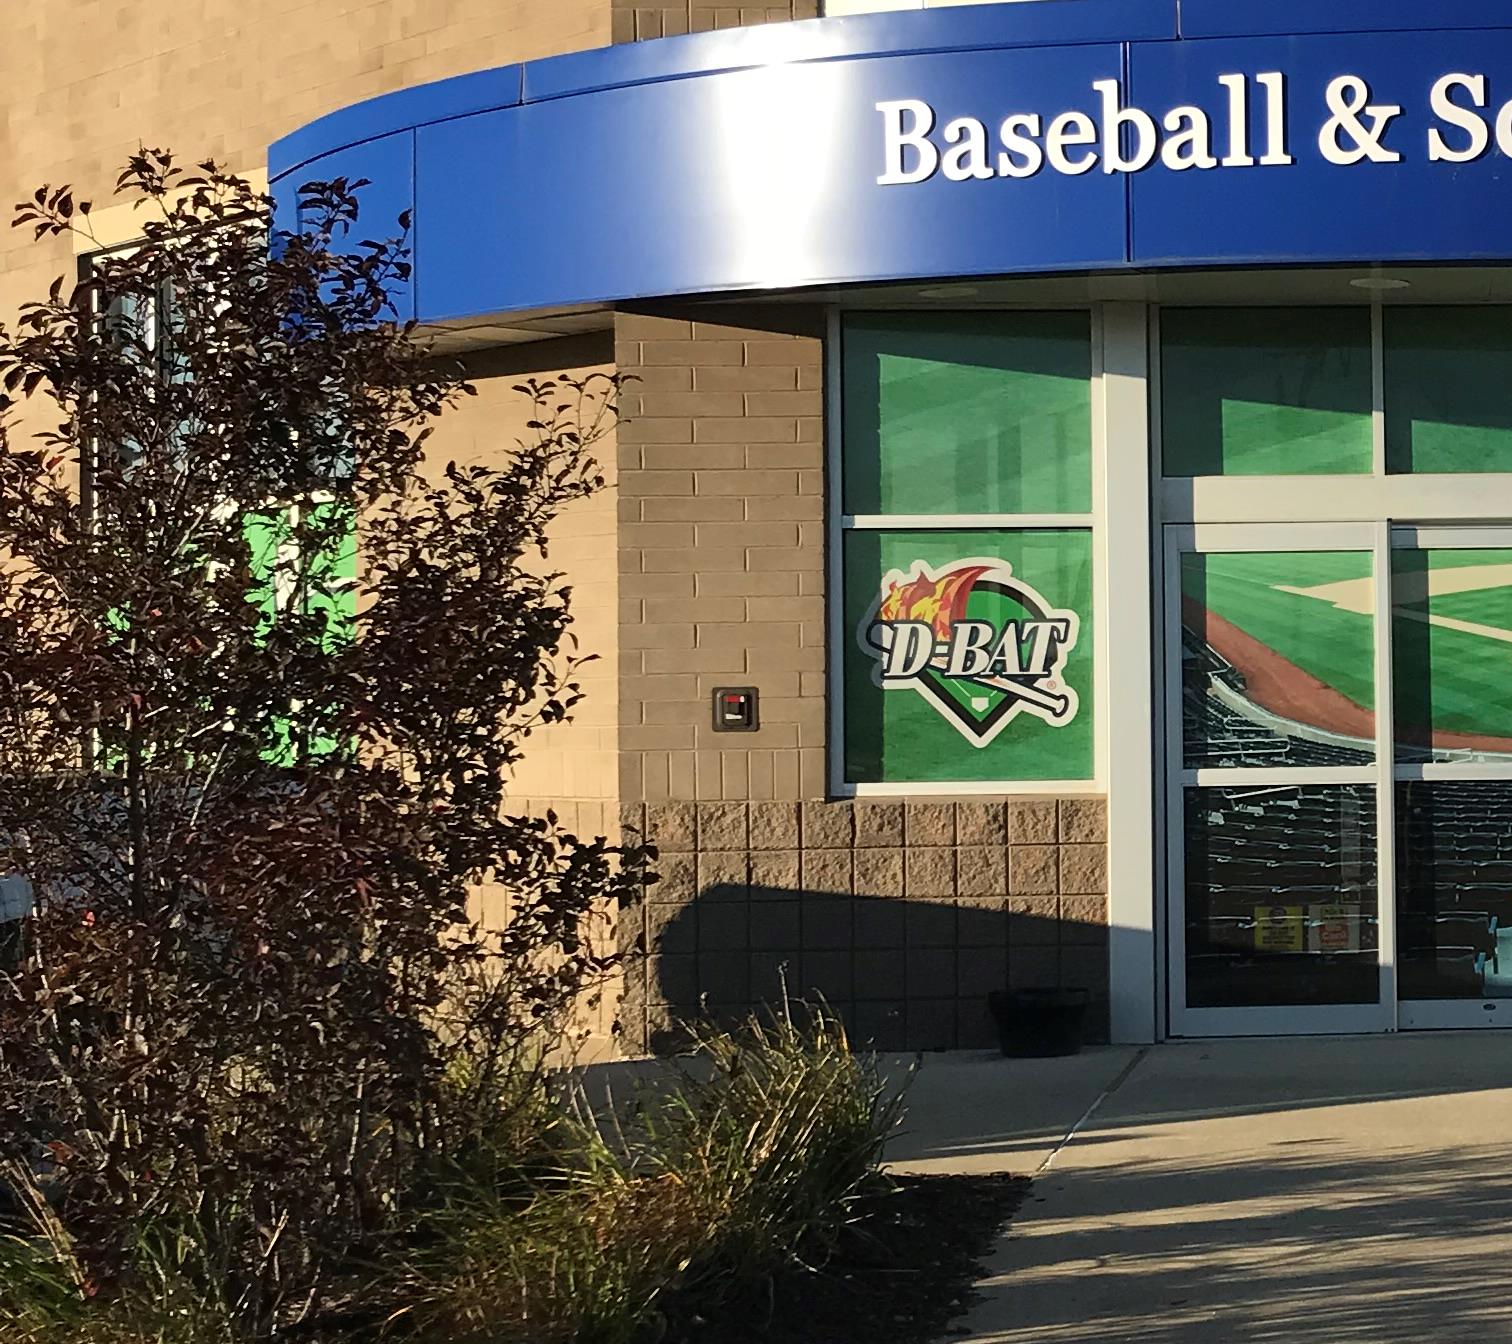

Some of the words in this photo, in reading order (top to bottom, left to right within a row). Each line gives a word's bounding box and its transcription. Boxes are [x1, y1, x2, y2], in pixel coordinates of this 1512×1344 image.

[875, 71, 1293, 186] Baseball
[1318, 74, 1401, 164] &
[883, 622, 1067, 677] D-BAT
